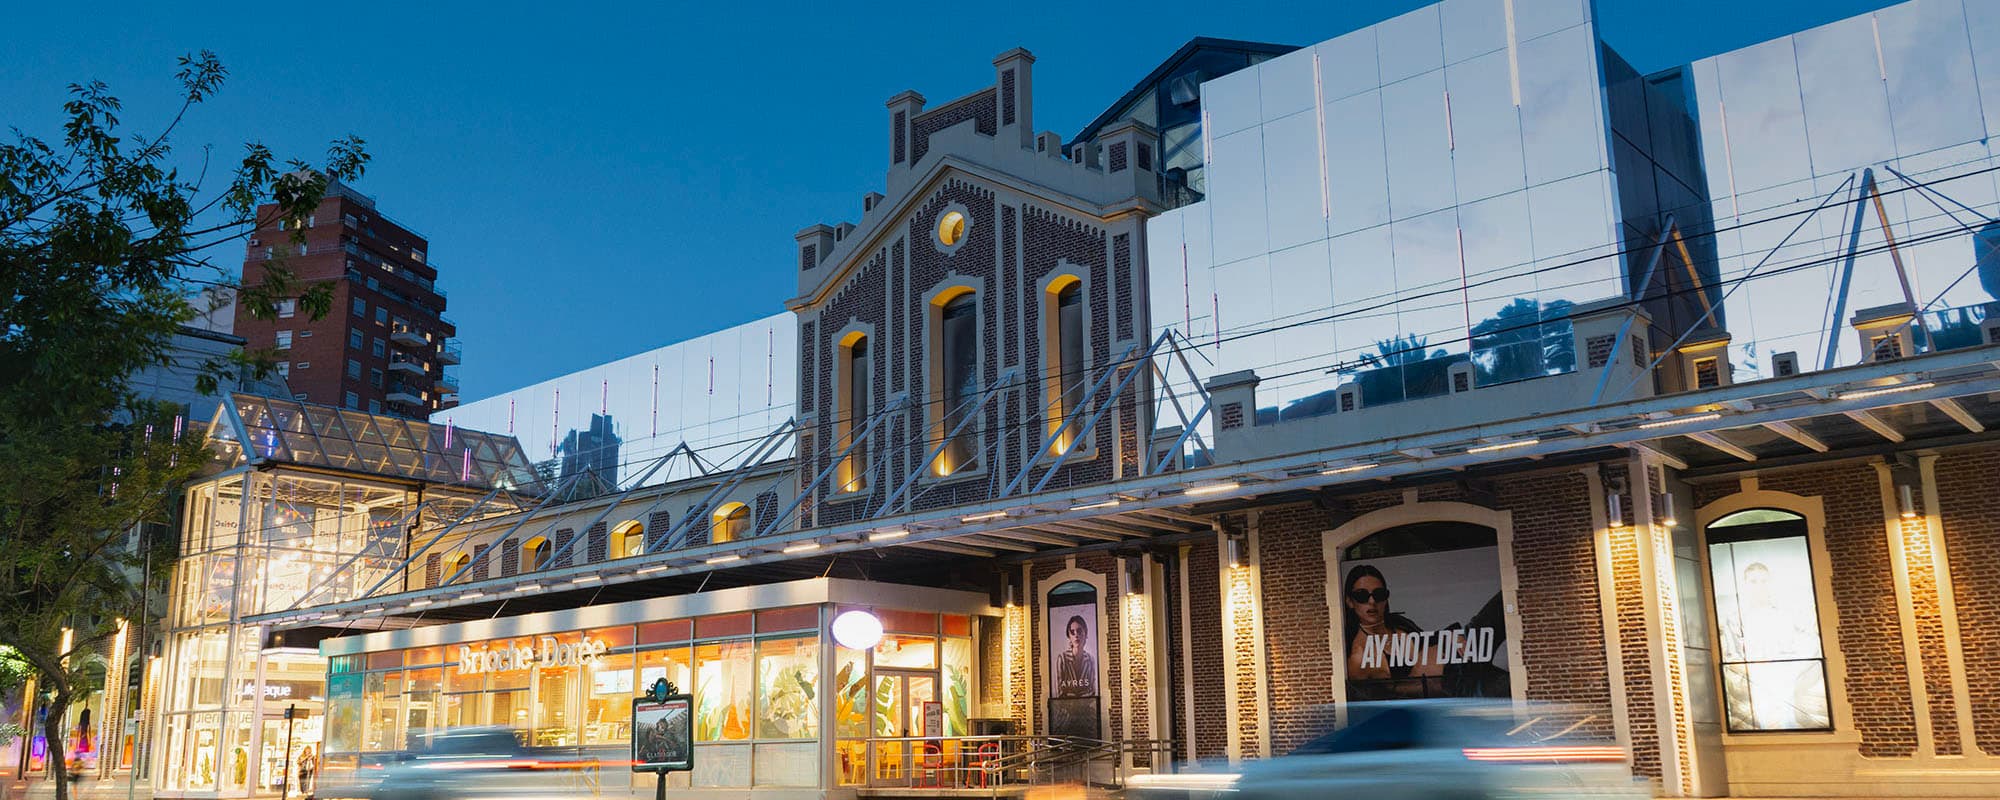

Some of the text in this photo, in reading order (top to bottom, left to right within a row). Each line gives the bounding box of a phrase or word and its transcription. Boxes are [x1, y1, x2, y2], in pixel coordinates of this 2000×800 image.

[458, 635, 607, 675] Brioche Dorée
[1360, 626, 1495, 669] AY NOT DEAD
[1060, 678, 1090, 688] AYRES
